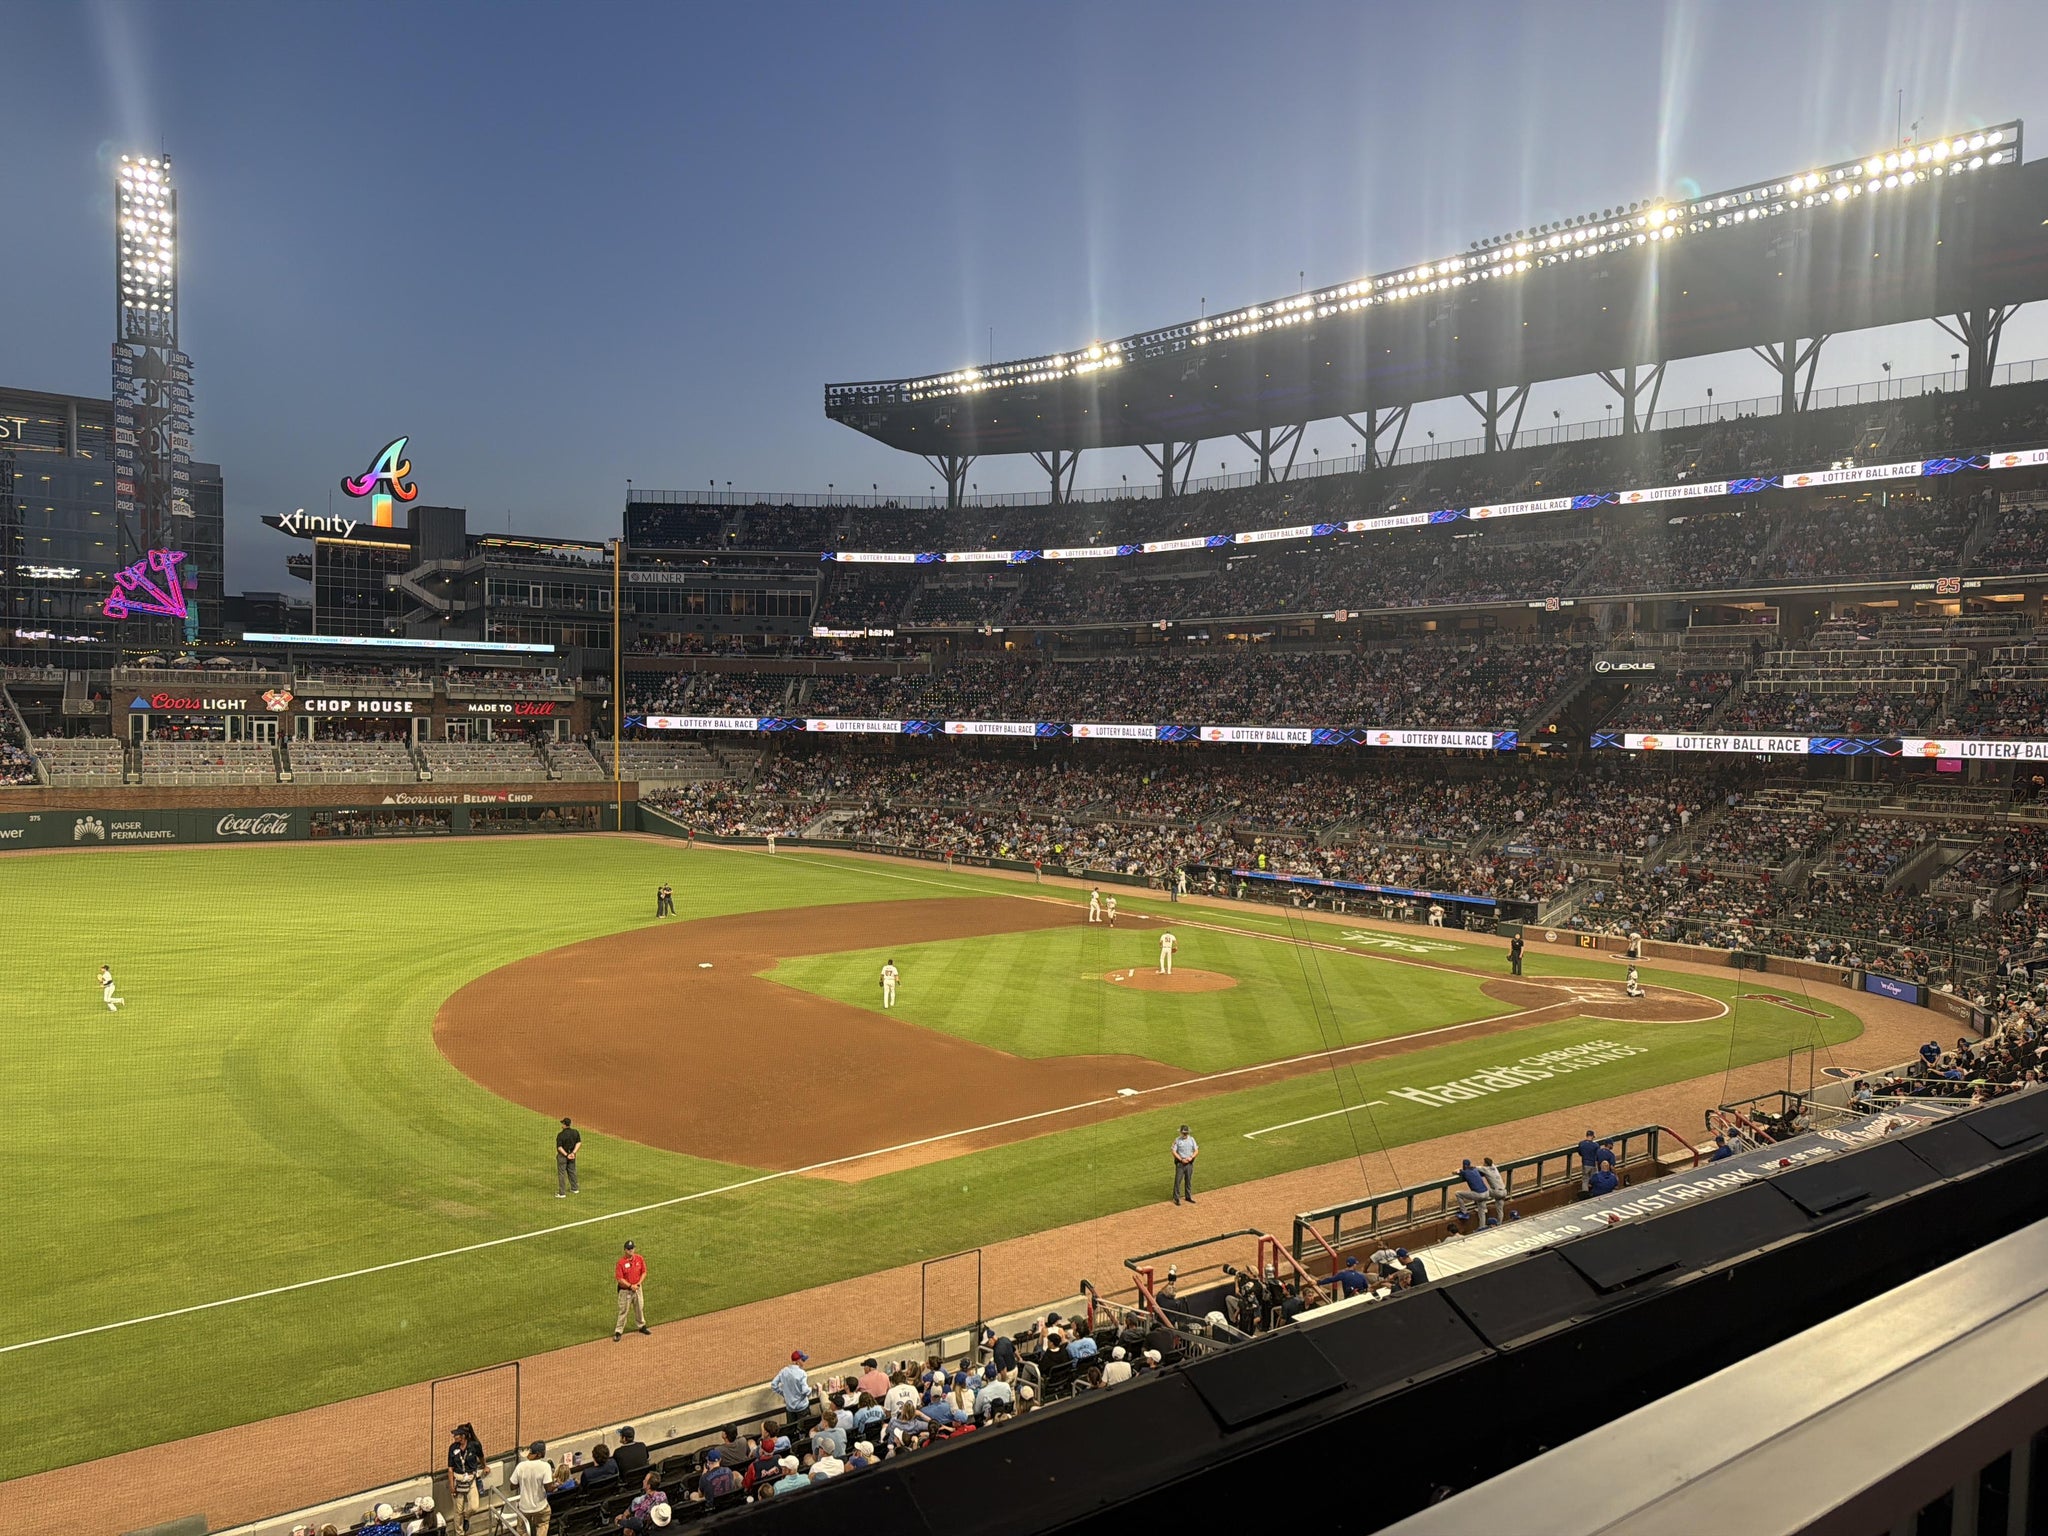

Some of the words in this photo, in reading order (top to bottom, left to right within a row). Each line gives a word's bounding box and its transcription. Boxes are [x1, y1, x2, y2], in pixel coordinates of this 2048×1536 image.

[172, 353, 188, 364] 1997
[172, 370, 189, 381] 1999
[116, 380, 134, 392] 2000
[172, 386, 188, 398] 2001
[116, 397, 134, 409] 2002
[172, 403, 189, 414] 2003
[116, 414, 134, 426] 2004
[172, 420, 189, 431] 2005
[117, 432, 133, 442] 2010
[172, 436, 189, 447] 2012
[117, 448, 133, 459] 2013
[172, 454, 189, 464] 2018
[117, 465, 133, 476] 2019
[173, 470, 189, 481] 2020
[1822, 470, 1863, 482] LOTTERY
[1866, 467, 1889, 478] BALL
[1892, 464, 1916, 476] RACE
[117, 482, 134, 493] 2021
[173, 486, 189, 498] 2022
[1650, 488, 1682, 499] LOTTERY
[1684, 486, 1703, 497] BALL
[1704, 484, 1723, 494] RACE
[117, 500, 134, 511] 2023
[1498, 504, 1530, 515] LOTTERY
[1531, 502, 1548, 512] BALL
[1550, 500, 1568, 510] RACE
[278, 508, 357, 538] xfinity
[1370, 520, 1395, 528] LOTTERY
[1396, 517, 1410, 526] BALL
[1410, 515, 1425, 524] RACE
[1257, 532, 1280, 540] LOTTERY
[1281, 530, 1296, 538] BALL
[1296, 528, 1309, 536] RACE
[641, 573, 682, 582] MILNER
[1936, 577, 1960, 594] 25
[1962, 580, 1981, 588] JONES
[1546, 597, 1560, 612] 21
[1335, 610, 1347, 622] 10
[1612, 662, 1656, 670] LEXUS
[151, 693, 202, 710] Coors
[202, 699, 247, 710] LIGHT
[304, 700, 351, 712] CHOP
[358, 700, 414, 712] HOUSE
[468, 704, 497, 712] MADE
[500, 704, 512, 712] TO
[514, 701, 556, 716] Chill
[679, 719, 712, 728] LOTTERY
[714, 720, 733, 728] BALL
[734, 720, 754, 728] RACE
[835, 721, 865, 730] LOTTERY
[866, 722, 882, 731] BALL
[883, 722, 898, 732] RACE
[974, 724, 1003, 733] LOTTERY
[1004, 724, 1018, 734] BALL
[1018, 724, 1032, 734] RACE
[1096, 726, 1121, 736] LOTTERY
[1122, 727, 1136, 737] BALL
[1138, 728, 1152, 738] RACE
[1231, 730, 1264, 740] LOTTERY
[1266, 730, 1286, 741] BALL
[1287, 730, 1307, 742] RACE
[1402, 733, 1438, 744] LOTTERY
[1441, 734, 1462, 745] BALL
[1465, 735, 1488, 746] RACE
[1676, 737, 1730, 750] LOTTERY
[1733, 738, 1765, 750] BALL
[1768, 738, 1801, 752] RACE
[1960, 742, 2021, 757] LOTTERY
[396, 792, 428, 804] Coors
[429, 796, 458, 804] LIGHT
[464, 794, 496, 804] BELOW
[508, 794, 534, 802] CHOP
[111, 822, 142, 830] KAISER
[216, 812, 293, 836] Coca-Cola
[111, 830, 172, 840] PERMANENTE
[1519, 1039, 1622, 1066] CHEROKEE
[1546, 1044, 1649, 1073] CASINOS
[1488, 1230, 1562, 1258] WELCOME
[1555, 1224, 1582, 1236] TO
[1582, 1194, 1676, 1225] TRUIST
[1692, 1168, 1762, 1191] PARK
[1803, 1146, 1832, 1156] THE
